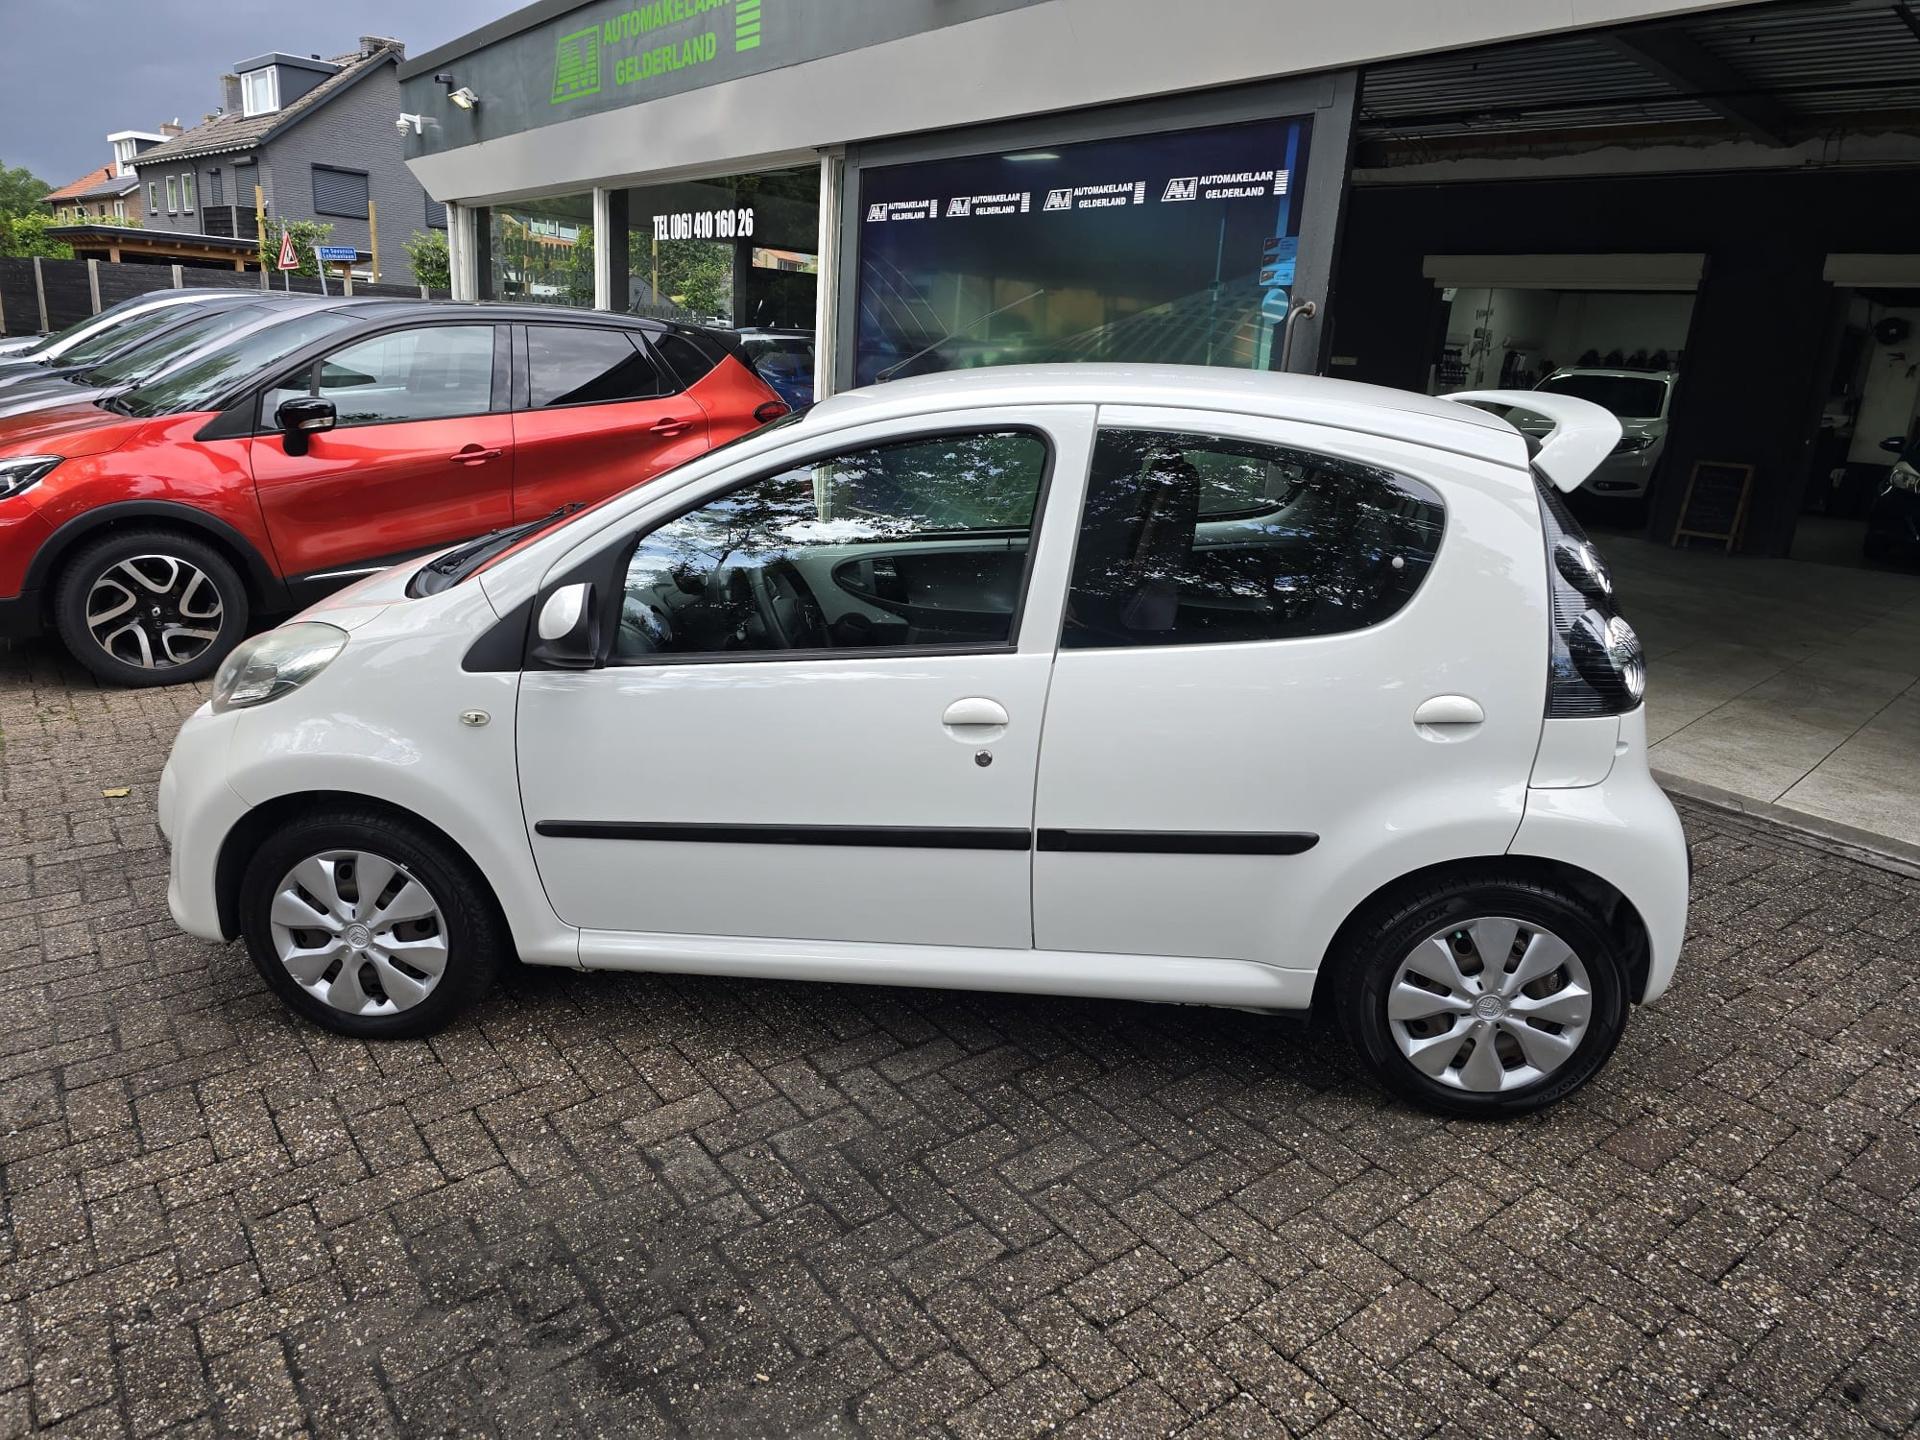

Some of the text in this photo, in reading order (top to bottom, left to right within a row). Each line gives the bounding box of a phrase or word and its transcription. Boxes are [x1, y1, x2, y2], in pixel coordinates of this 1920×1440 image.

[614, 32, 717, 86] GELDERLAND
[1200, 171, 1273, 185] AUTOMAKELAAR
[1073, 183, 1133, 196] AUTOMAKELAAR
[1205, 187, 1265, 199] GELDERLAND
[971, 193, 1020, 204] AUTOMAKELAAR
[1079, 197, 1126, 209] GELDERLAND
[975, 206, 1015, 215] GELDERLAND
[653, 208, 753, 240] TEL (06) 410 160 26
